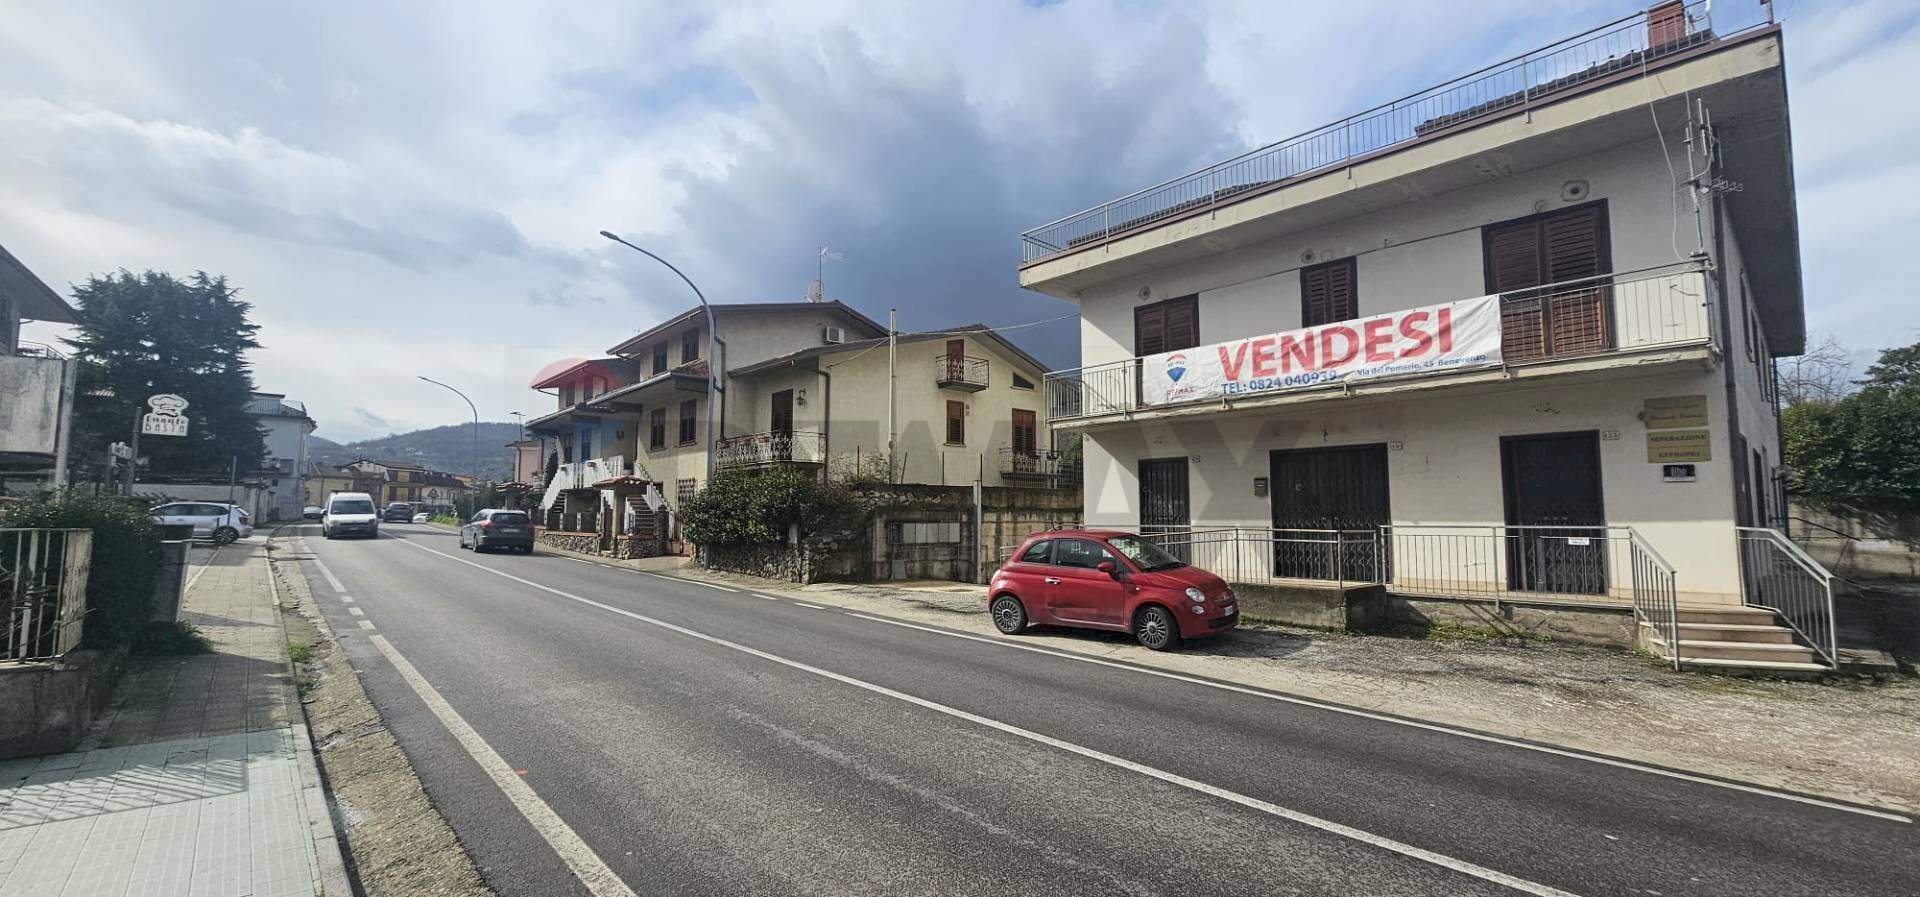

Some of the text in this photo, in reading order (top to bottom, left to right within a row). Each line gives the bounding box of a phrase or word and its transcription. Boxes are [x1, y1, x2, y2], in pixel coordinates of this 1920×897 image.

[1217, 308, 1453, 382] VENDESI
[1357, 368, 1370, 376] Via
[1372, 366, 1384, 374] del
[1438, 354, 1486, 365] Benevento
[1221, 370, 1337, 395] TEL: 0824 040939
